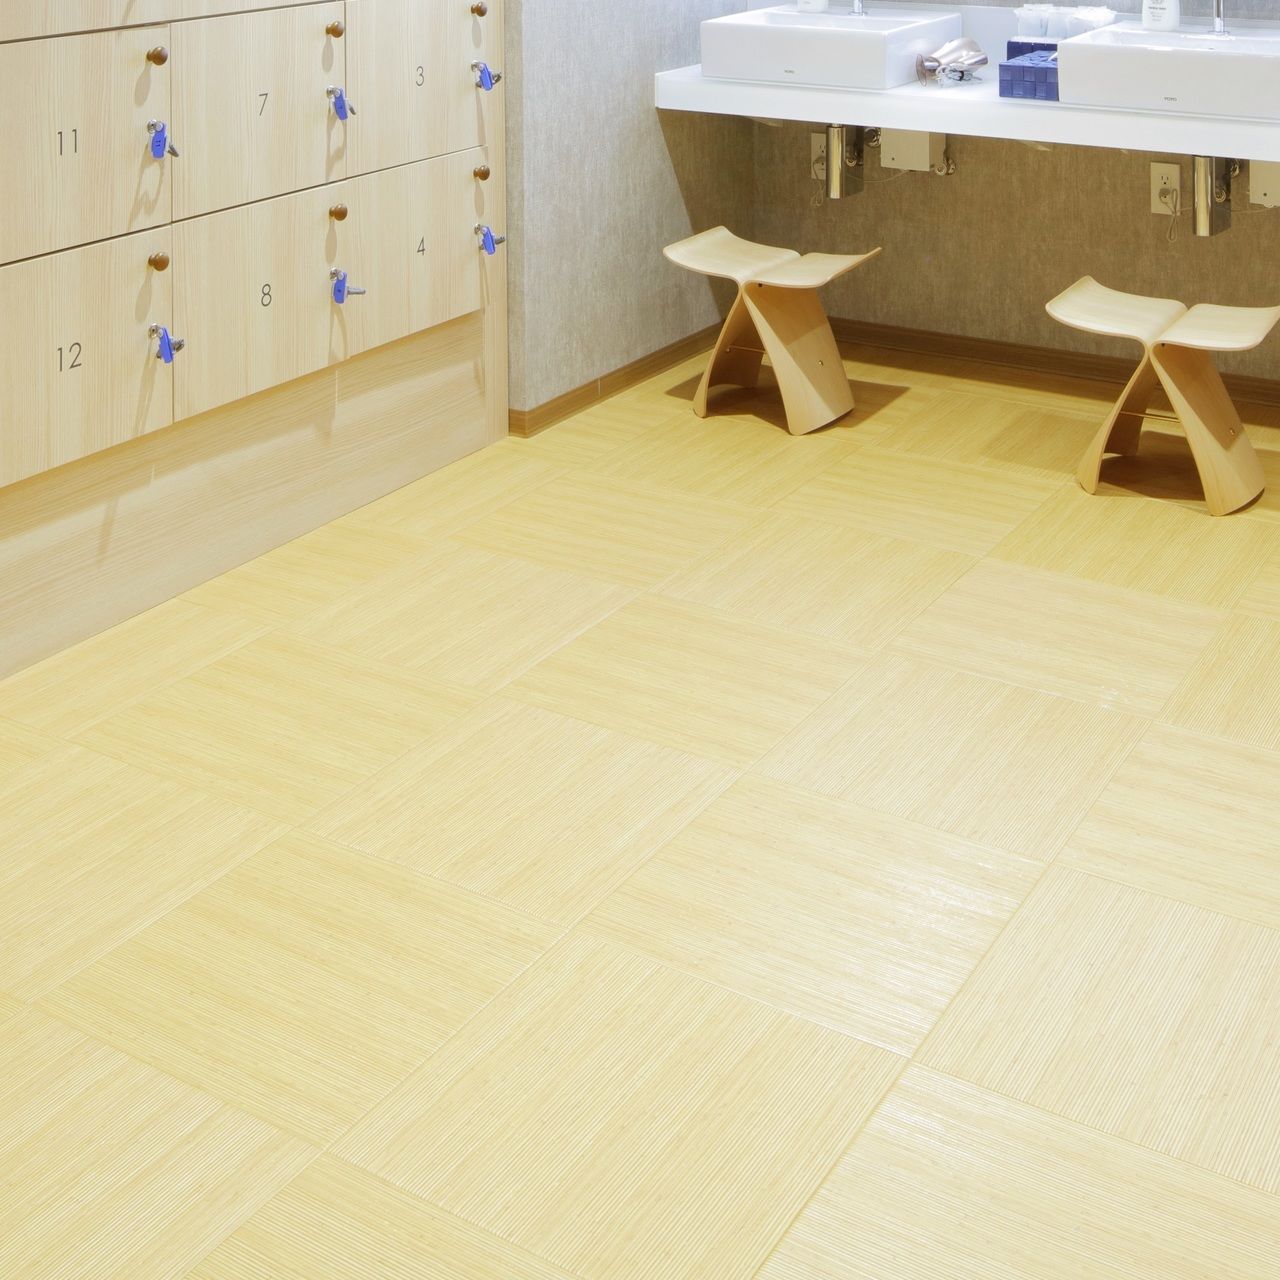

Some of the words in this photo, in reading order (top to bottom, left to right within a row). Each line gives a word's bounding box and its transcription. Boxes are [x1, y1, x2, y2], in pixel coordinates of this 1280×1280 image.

[415, 65, 425, 87] 3
[258, 92, 269, 117] 7
[57, 128, 78, 156] 11
[416, 236, 426, 256] 4
[260, 283, 272, 308] 8
[57, 342, 83, 372] 12
